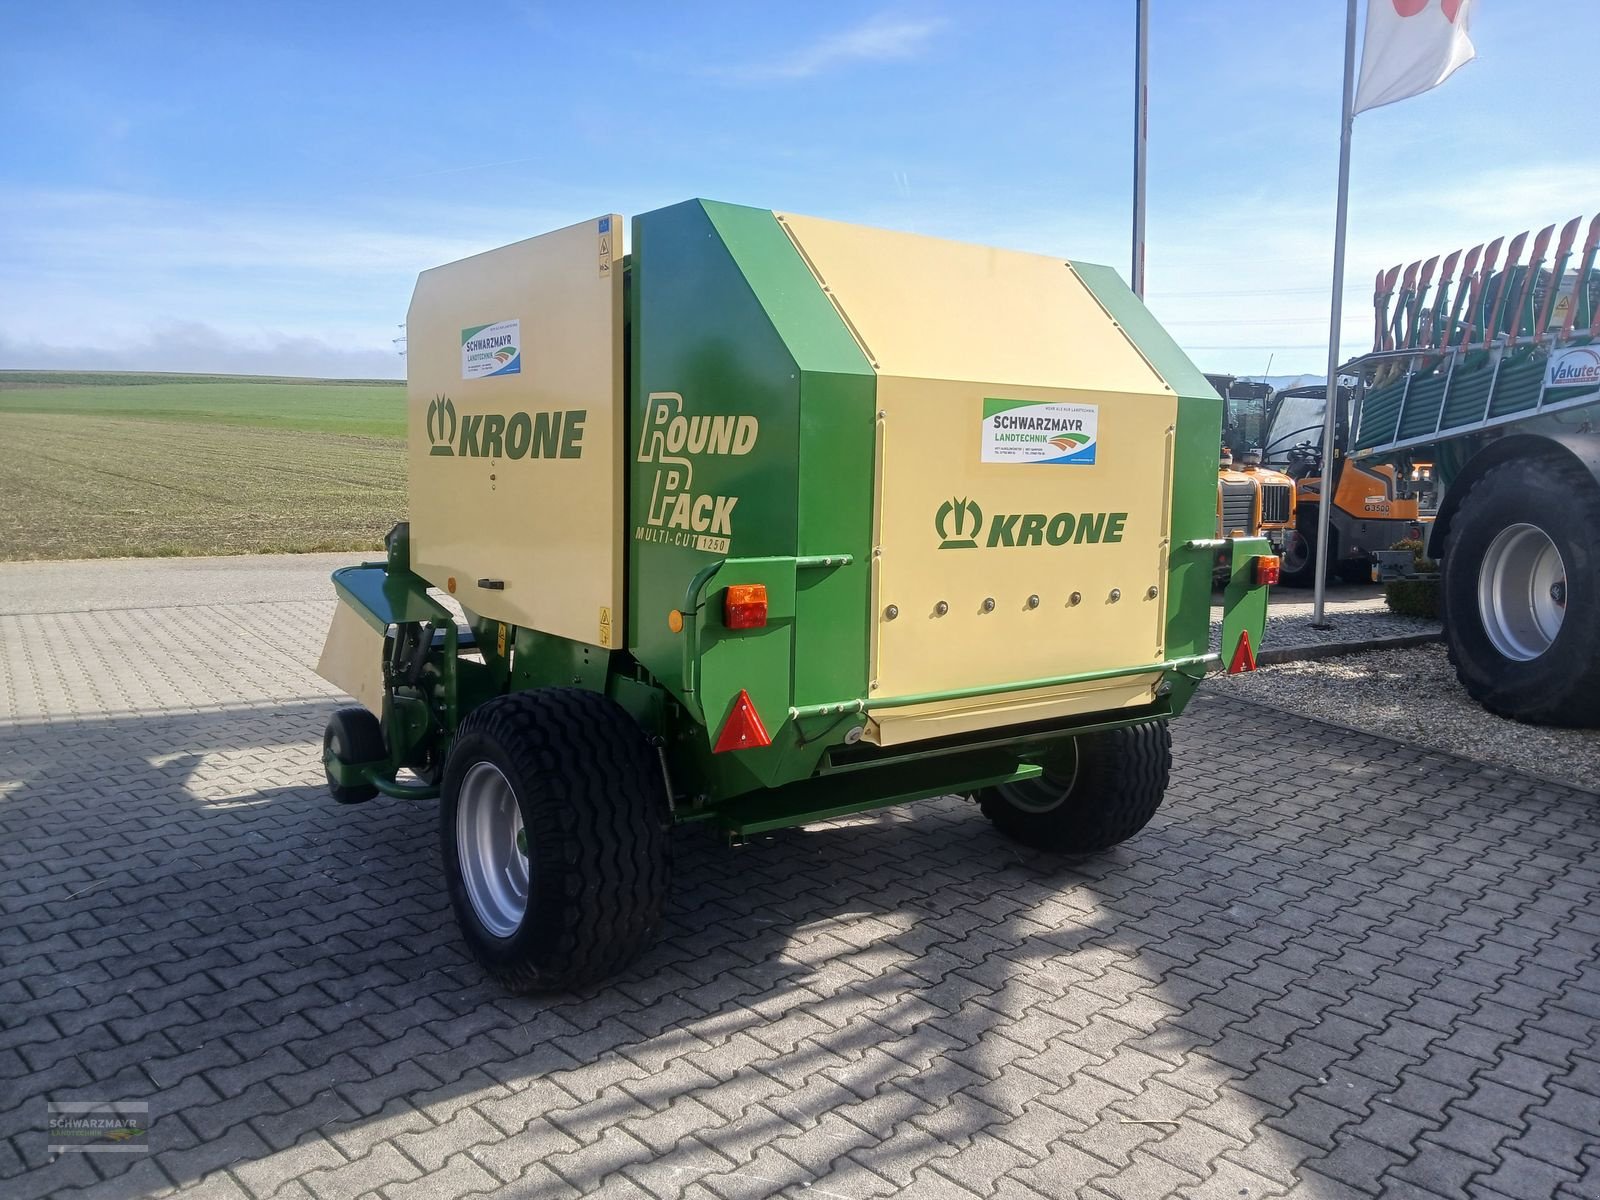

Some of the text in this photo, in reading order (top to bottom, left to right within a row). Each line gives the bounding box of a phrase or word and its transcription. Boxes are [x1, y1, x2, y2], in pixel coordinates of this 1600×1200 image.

[466, 334, 512, 352] SCHWARZMAYR
[458, 409, 587, 460] KRONE
[637, 391, 759, 463] ROUND
[993, 415, 1083, 431] SCHWARZMAYR
[995, 433, 1048, 443] LANDTECHNIK
[647, 456, 739, 536] PACK
[635, 526, 725, 551] MULTI-CUT 1250
[986, 512, 1129, 547] KRONE
